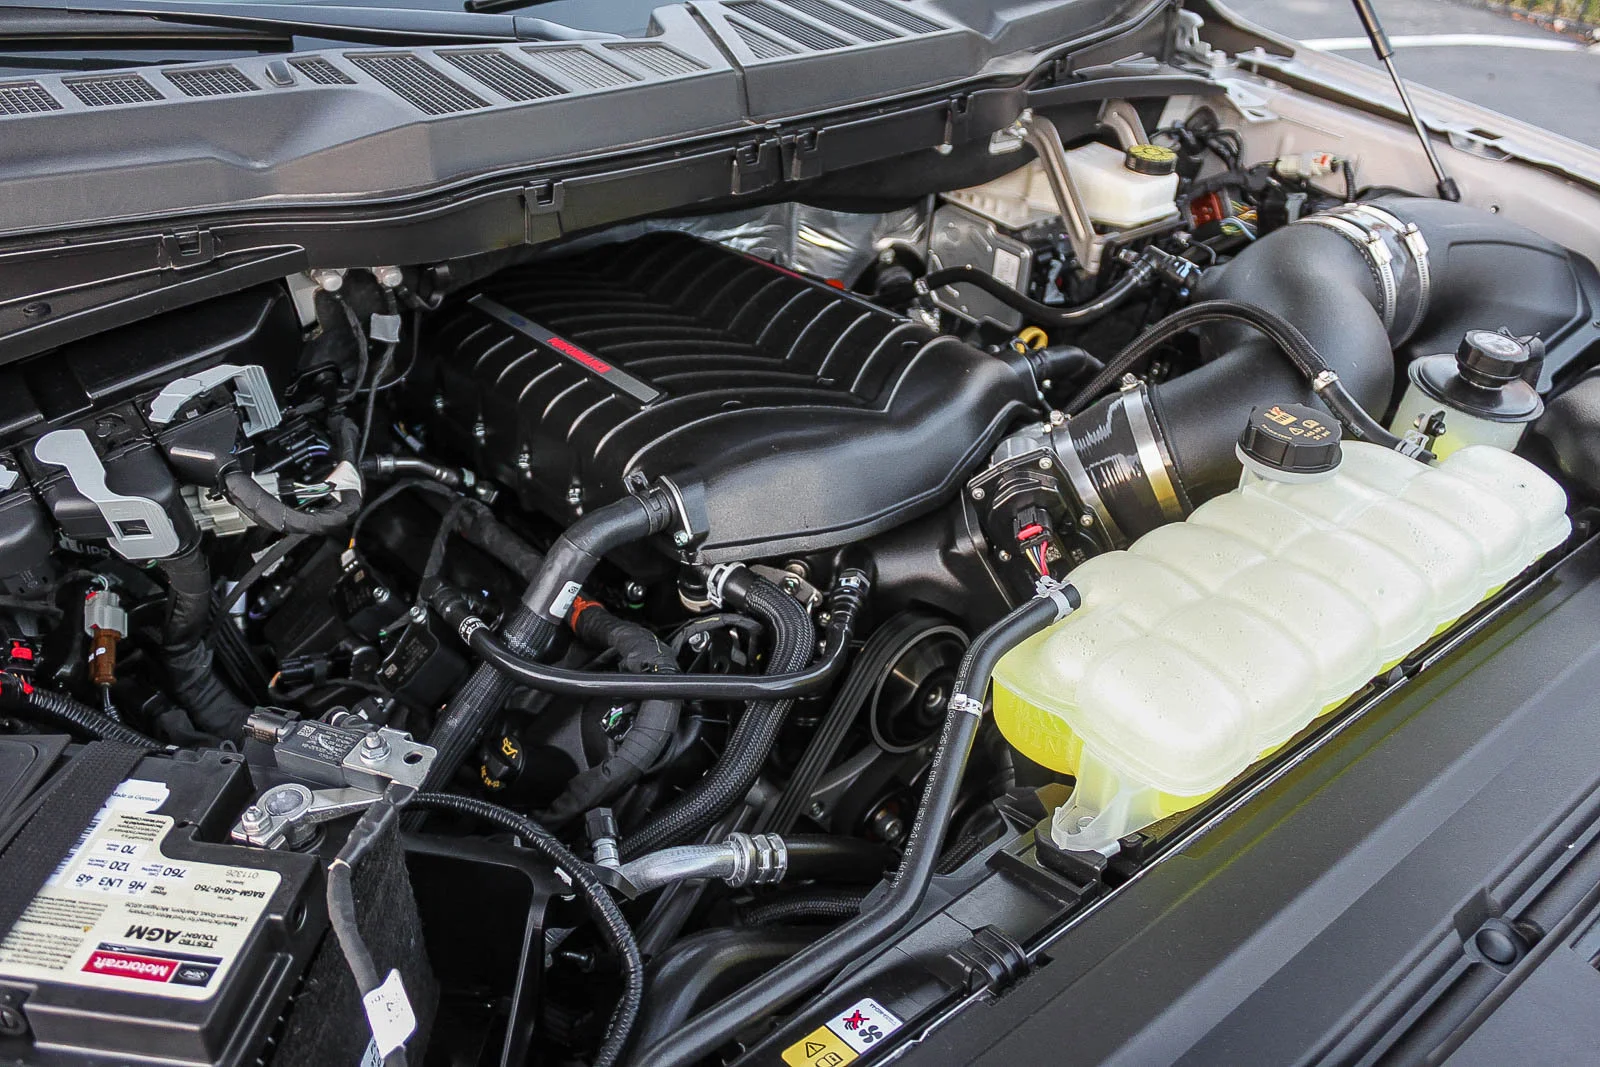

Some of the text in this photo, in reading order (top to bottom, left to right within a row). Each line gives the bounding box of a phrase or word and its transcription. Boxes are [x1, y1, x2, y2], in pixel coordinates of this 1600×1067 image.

[120, 845, 136, 854] 70
[109, 861, 130, 872] 120
[162, 867, 186, 878] 760
[76, 874, 147, 890] H6 LN3 48
[194, 884, 266, 898] BAGM-48H6-760
[124, 925, 182, 943] AGM
[178, 939, 213, 948] TESTED
[94, 957, 169, 976] Motorcraft
